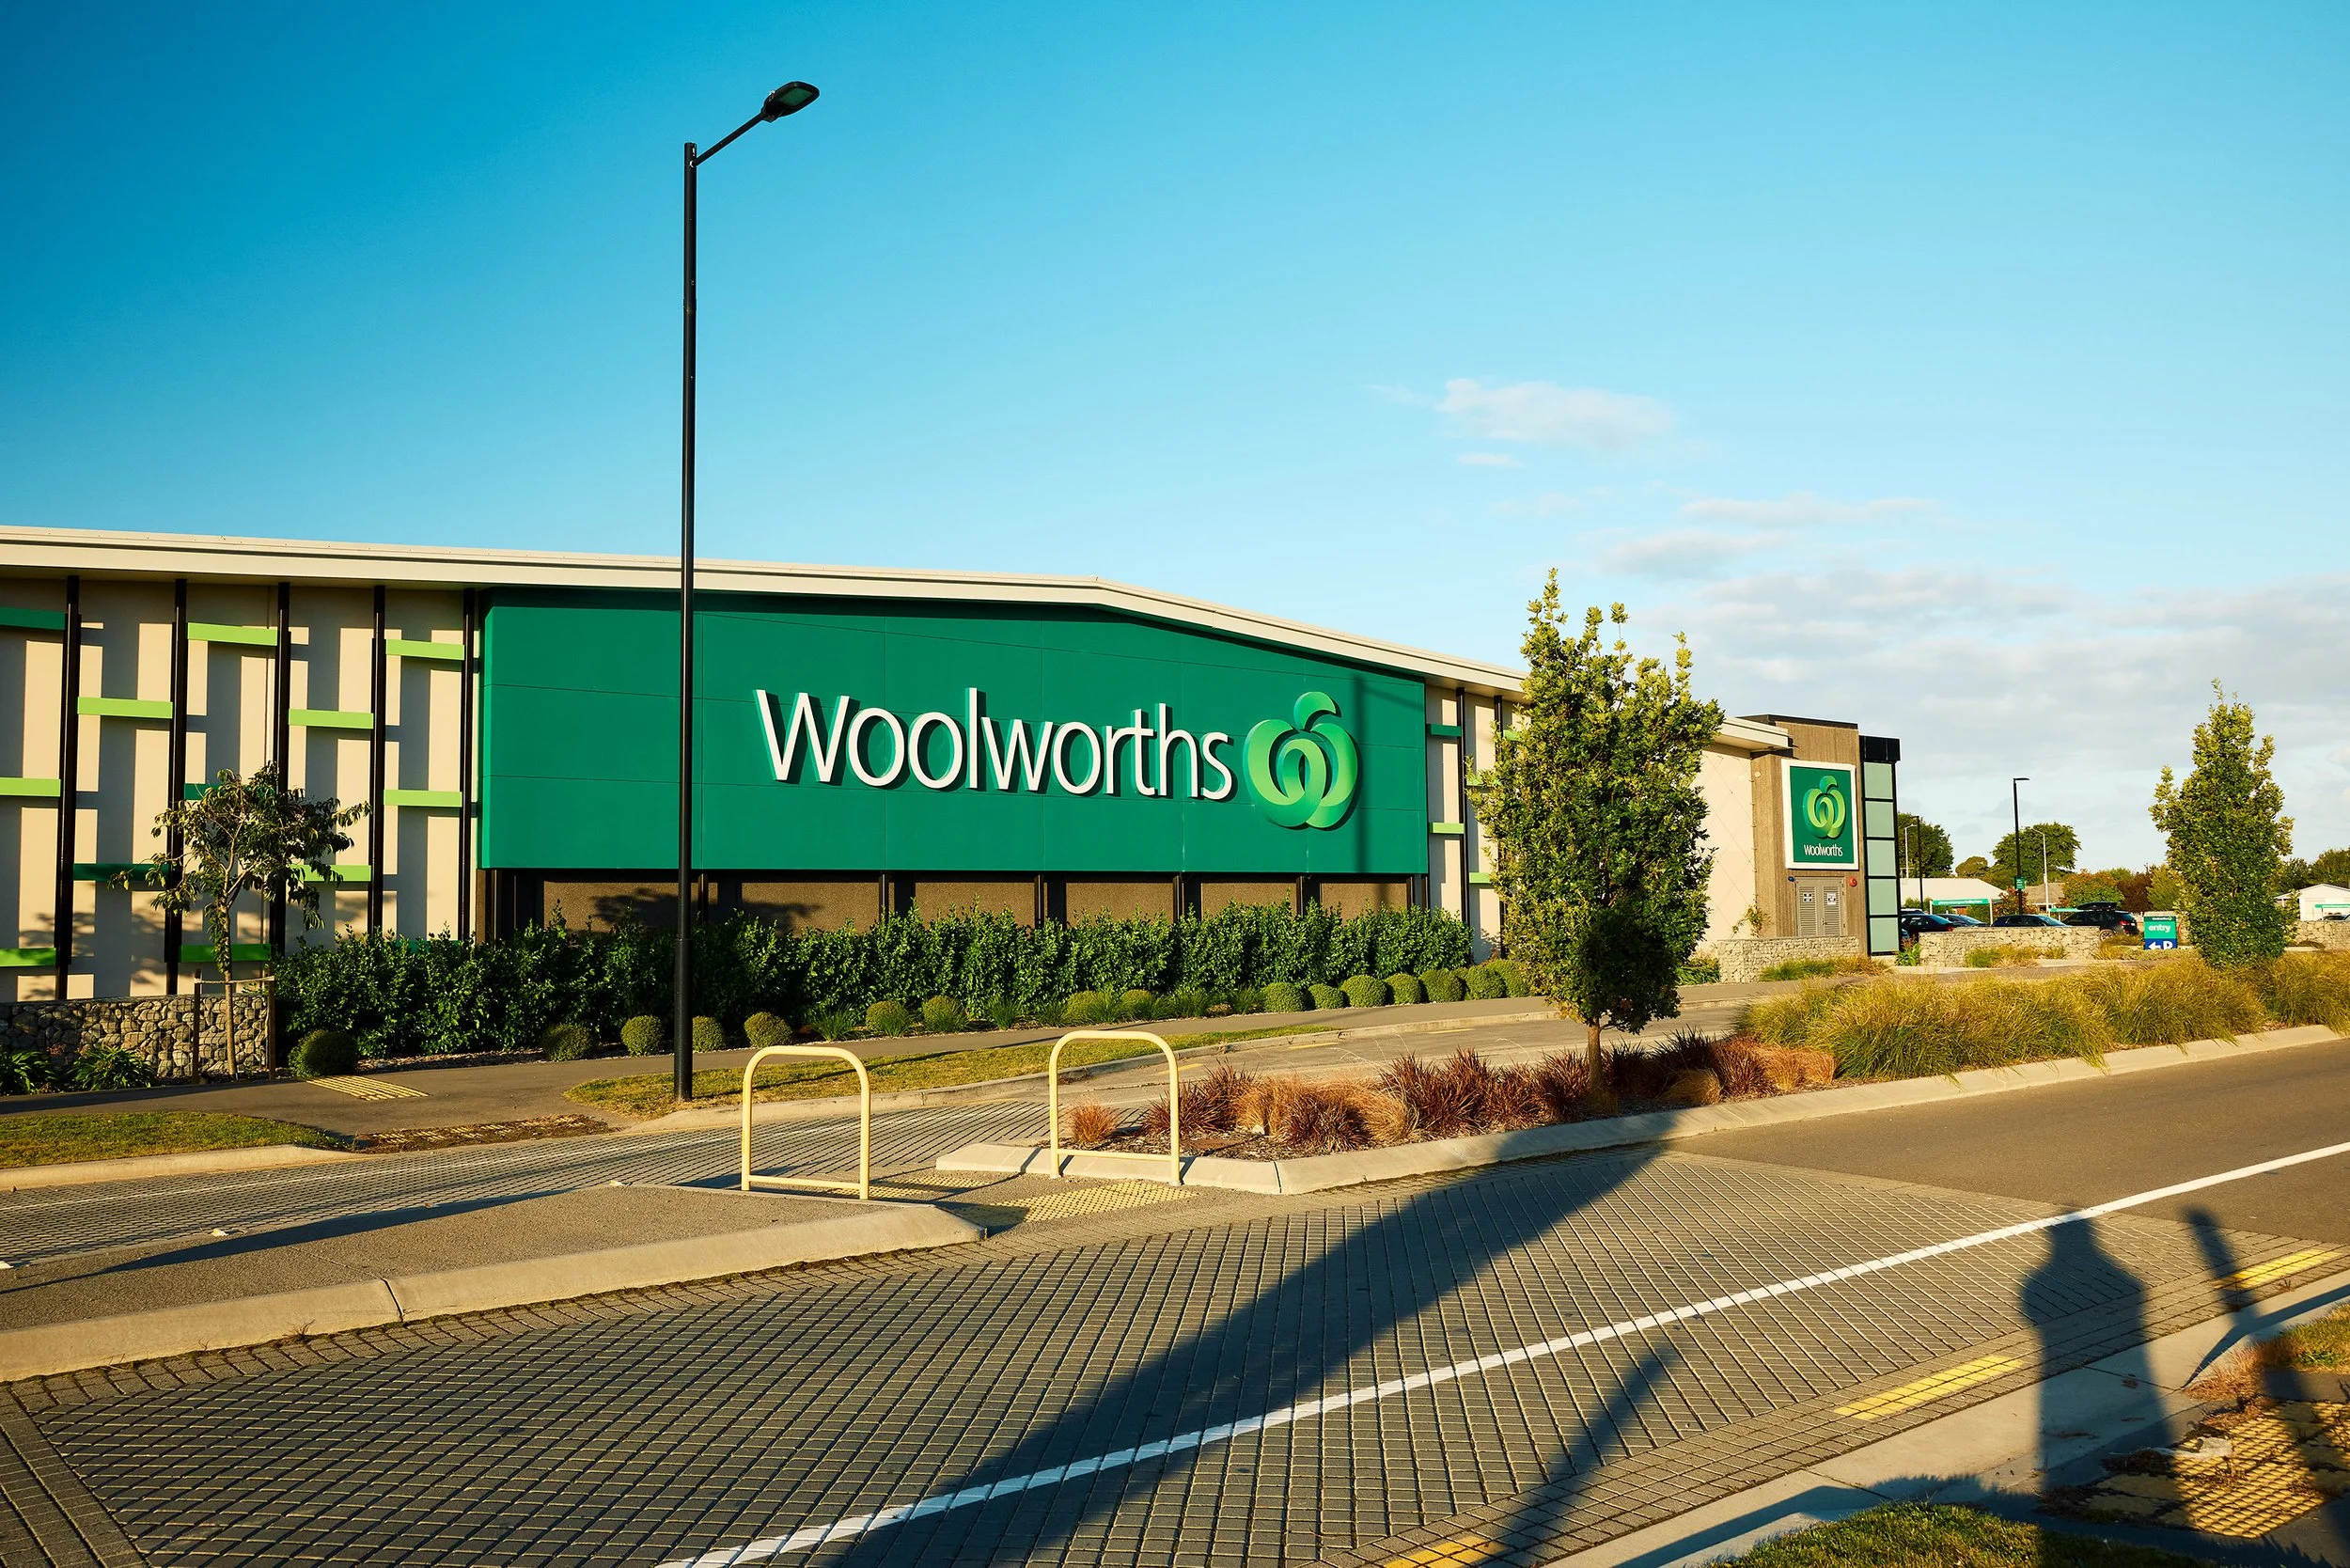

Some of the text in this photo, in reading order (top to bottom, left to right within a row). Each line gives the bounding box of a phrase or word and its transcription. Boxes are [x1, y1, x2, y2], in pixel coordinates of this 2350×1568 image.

[755, 686, 1233, 800] Woolworths
[1804, 843, 1843, 856] Woolworths
[2148, 924, 2170, 933] entry
[2163, 940, 2173, 950] P
